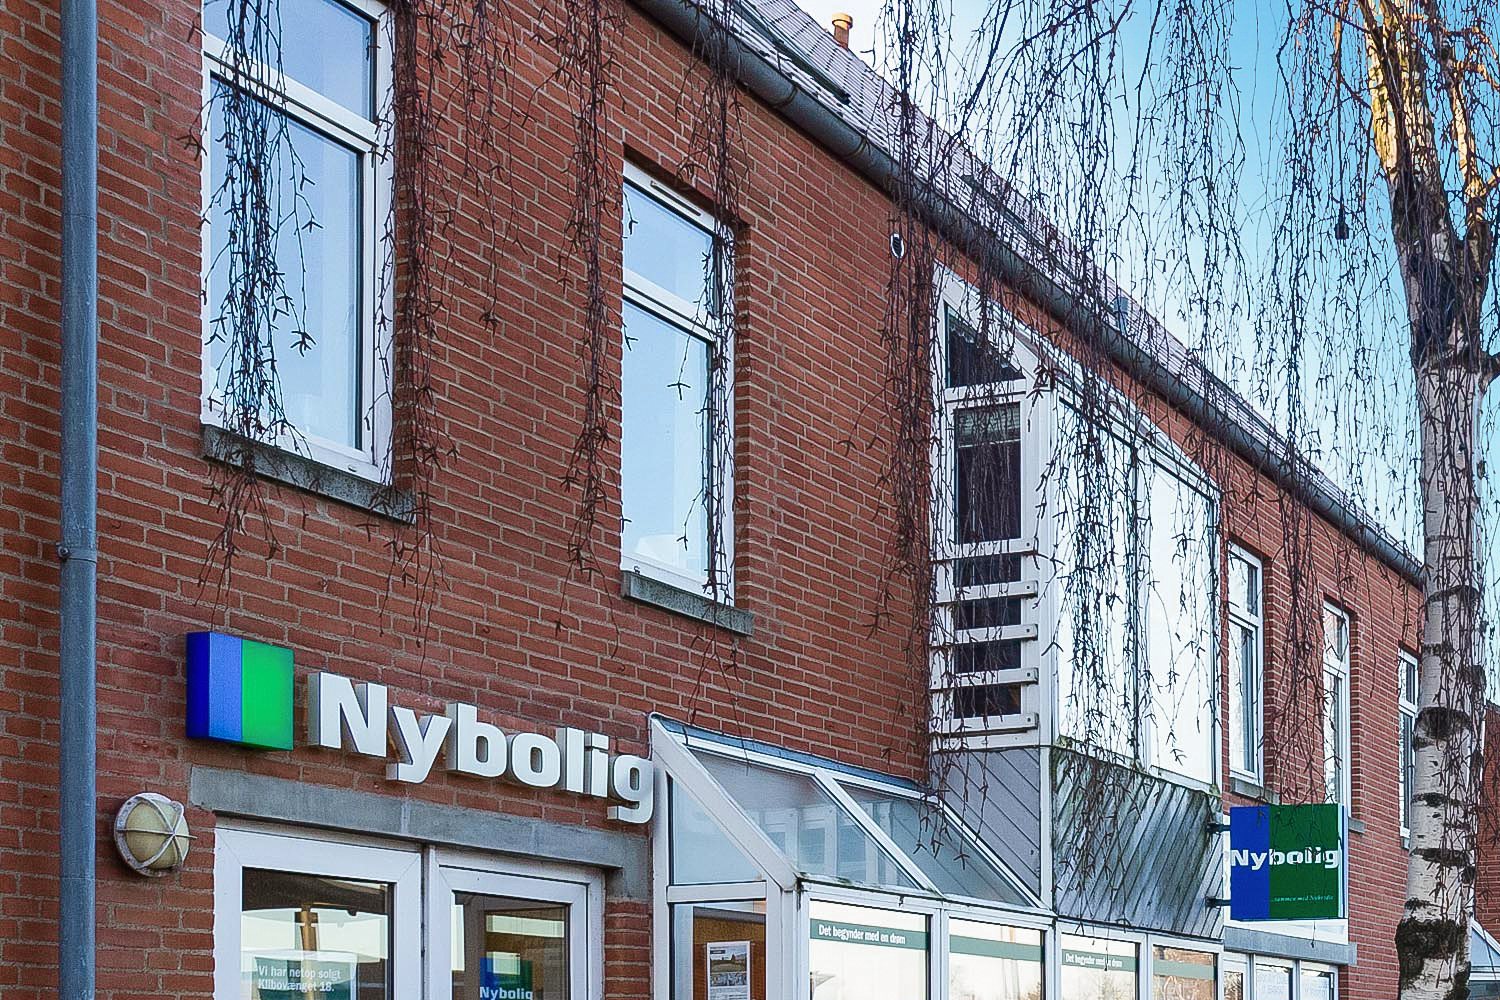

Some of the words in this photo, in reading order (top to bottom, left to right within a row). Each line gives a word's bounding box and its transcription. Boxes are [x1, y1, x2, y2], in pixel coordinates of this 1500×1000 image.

[308, 671, 654, 824] Nybolig
[1231, 846, 1340, 871] Nybolig
[818, 924, 831, 937] Det
[833, 926, 864, 940] begynder
[864, 930, 879, 942] med
[880, 933, 889, 943] en
[258, 965, 268, 976] Vi
[270, 966, 287, 977] har
[289, 967, 316, 980] netop
[318, 968, 341, 981] solgt
